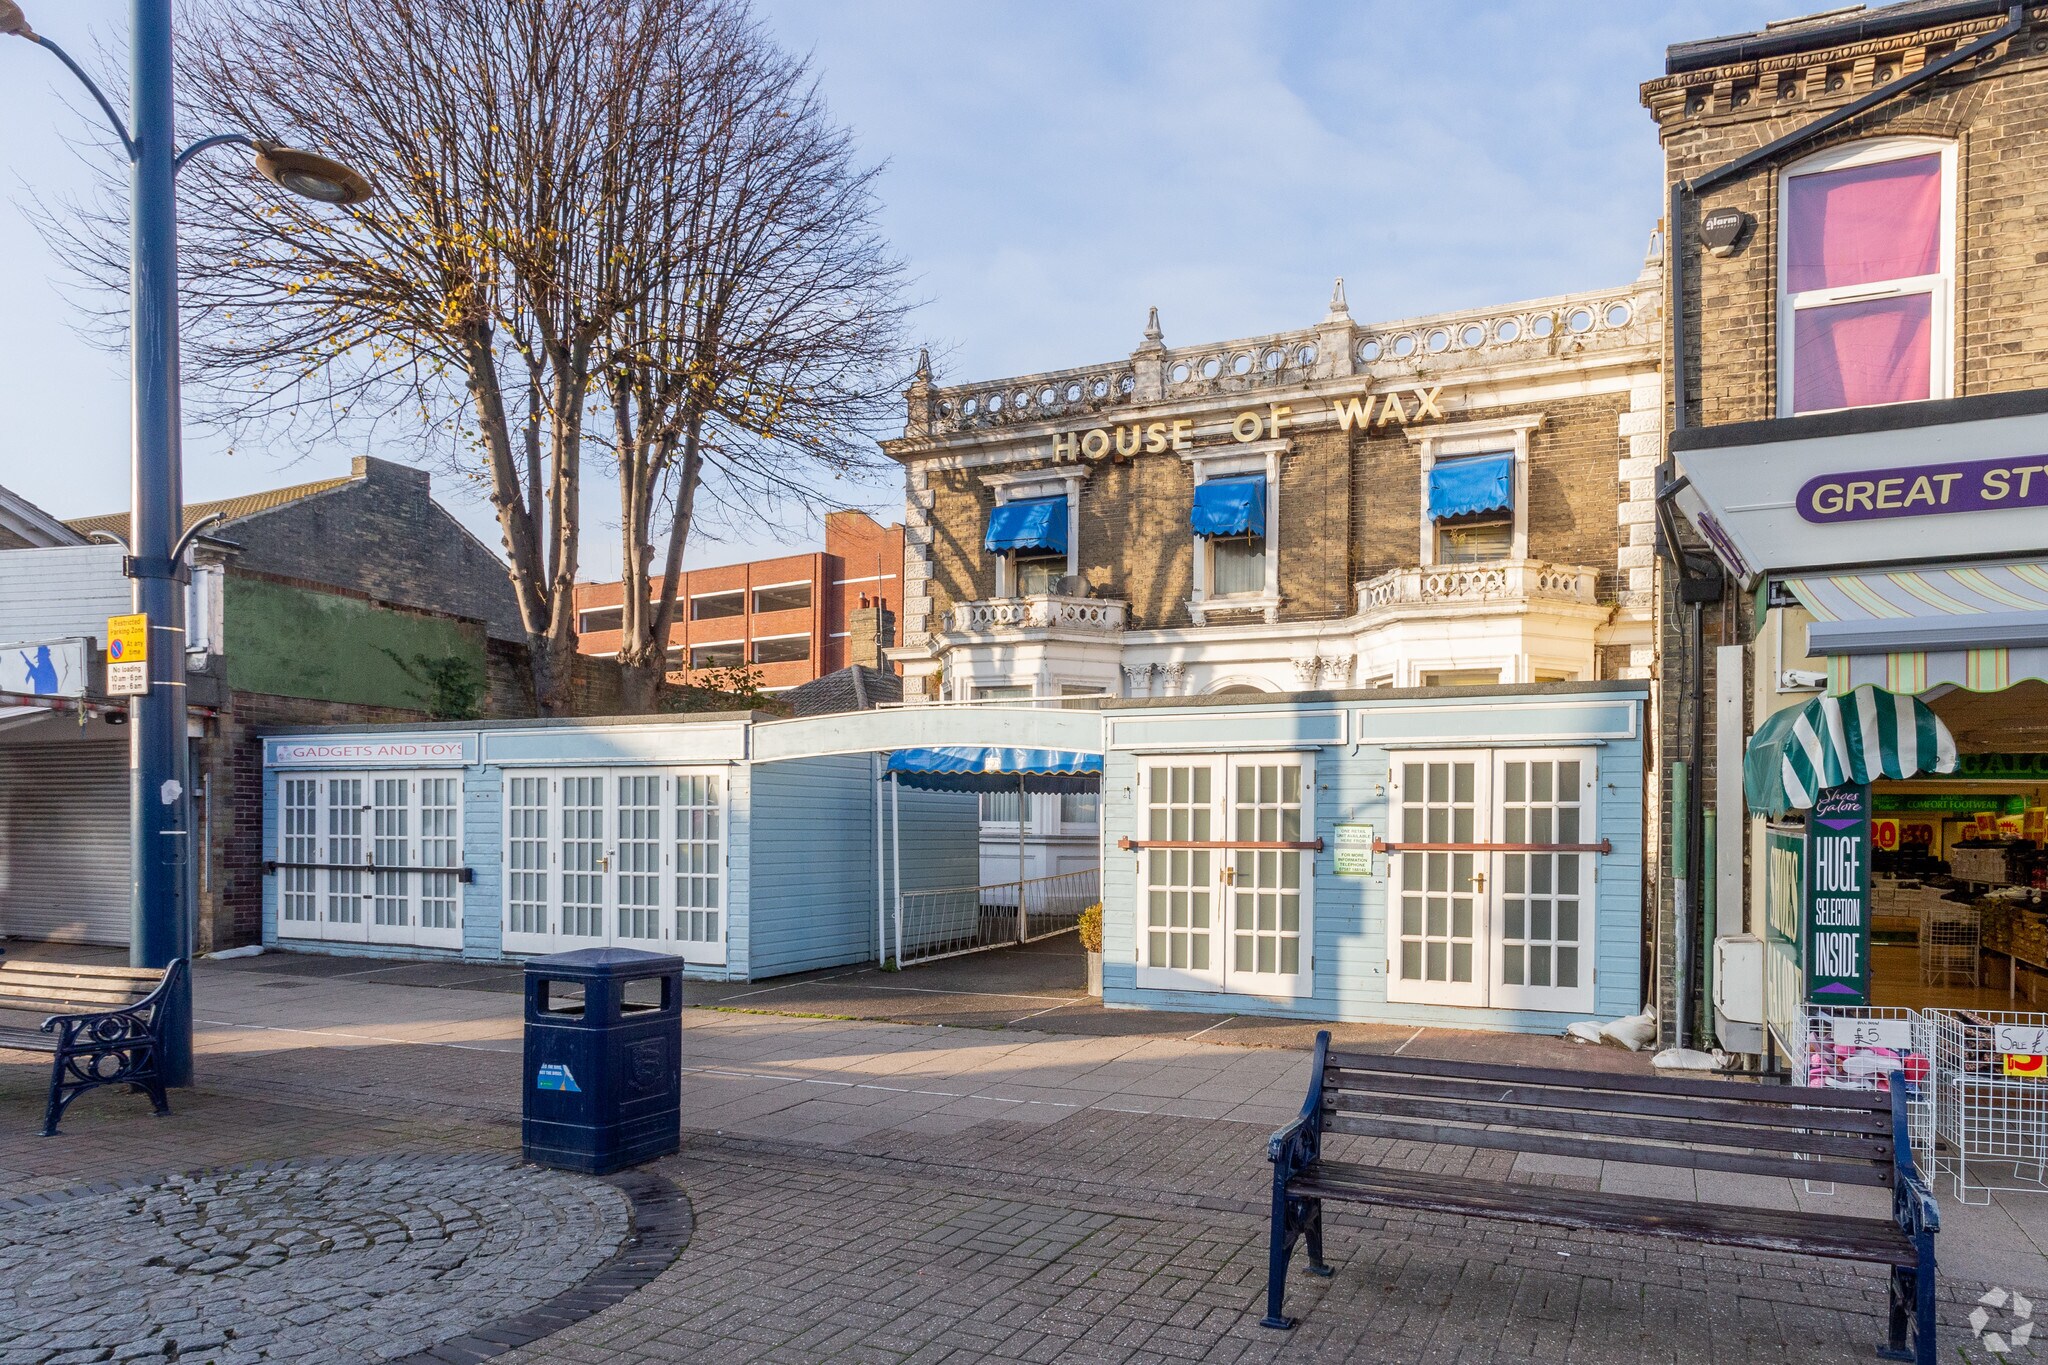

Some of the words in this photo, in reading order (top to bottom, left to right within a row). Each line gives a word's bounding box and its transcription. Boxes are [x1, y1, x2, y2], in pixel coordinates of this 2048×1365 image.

[1051, 419, 1194, 463] HOUSE
[1232, 406, 1293, 443] OF
[1333, 386, 1444, 431] WAX
[1811, 473, 1963, 514] GREAT
[1980, 465, 2048, 501] ST
[111, 628, 131, 636] Parking
[113, 618, 141, 627] Restricted
[293, 745, 373, 758] GADGETS
[377, 745, 417, 756] AND
[1819, 788, 1860, 803] Shoes
[1907, 801, 1947, 809] COMFORT
[1949, 801, 1998, 809] FOOTWEAR
[1816, 800, 1862, 817] Galore
[1816, 836, 1861, 892] HUGE
[1769, 846, 1798, 943] SHOES
[1815, 897, 1860, 927] SELECTION
[1815, 932, 1860, 978] INSIDE
